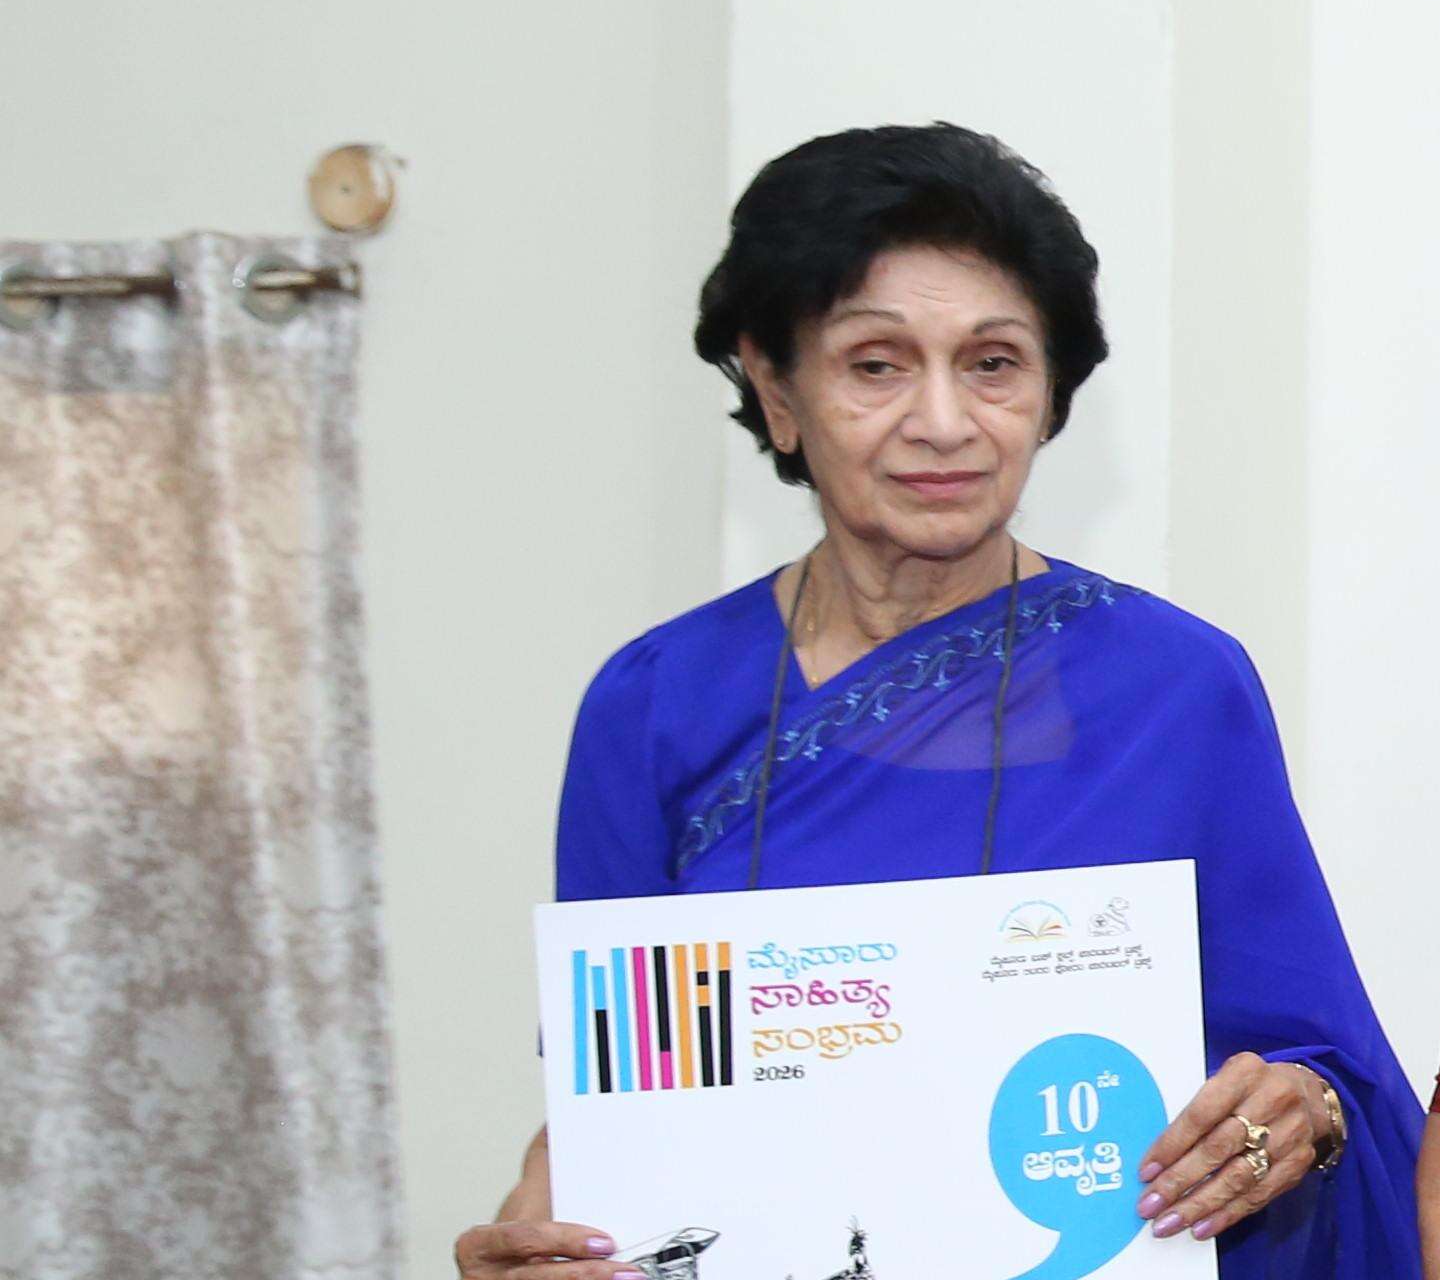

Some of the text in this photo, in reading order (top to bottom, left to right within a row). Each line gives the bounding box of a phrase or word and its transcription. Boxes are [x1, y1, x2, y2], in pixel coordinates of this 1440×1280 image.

[747, 942, 897, 979] ಮೈಸೂರು
[750, 979, 891, 1018] ಸಾಹಿತ್ಯ
[753, 1021, 903, 1059] ಸಂಭ್ರಮ
[754, 1065, 805, 1081] 2026
[1022, 1142, 1122, 1196] ಆವೃತ್ತಿ
